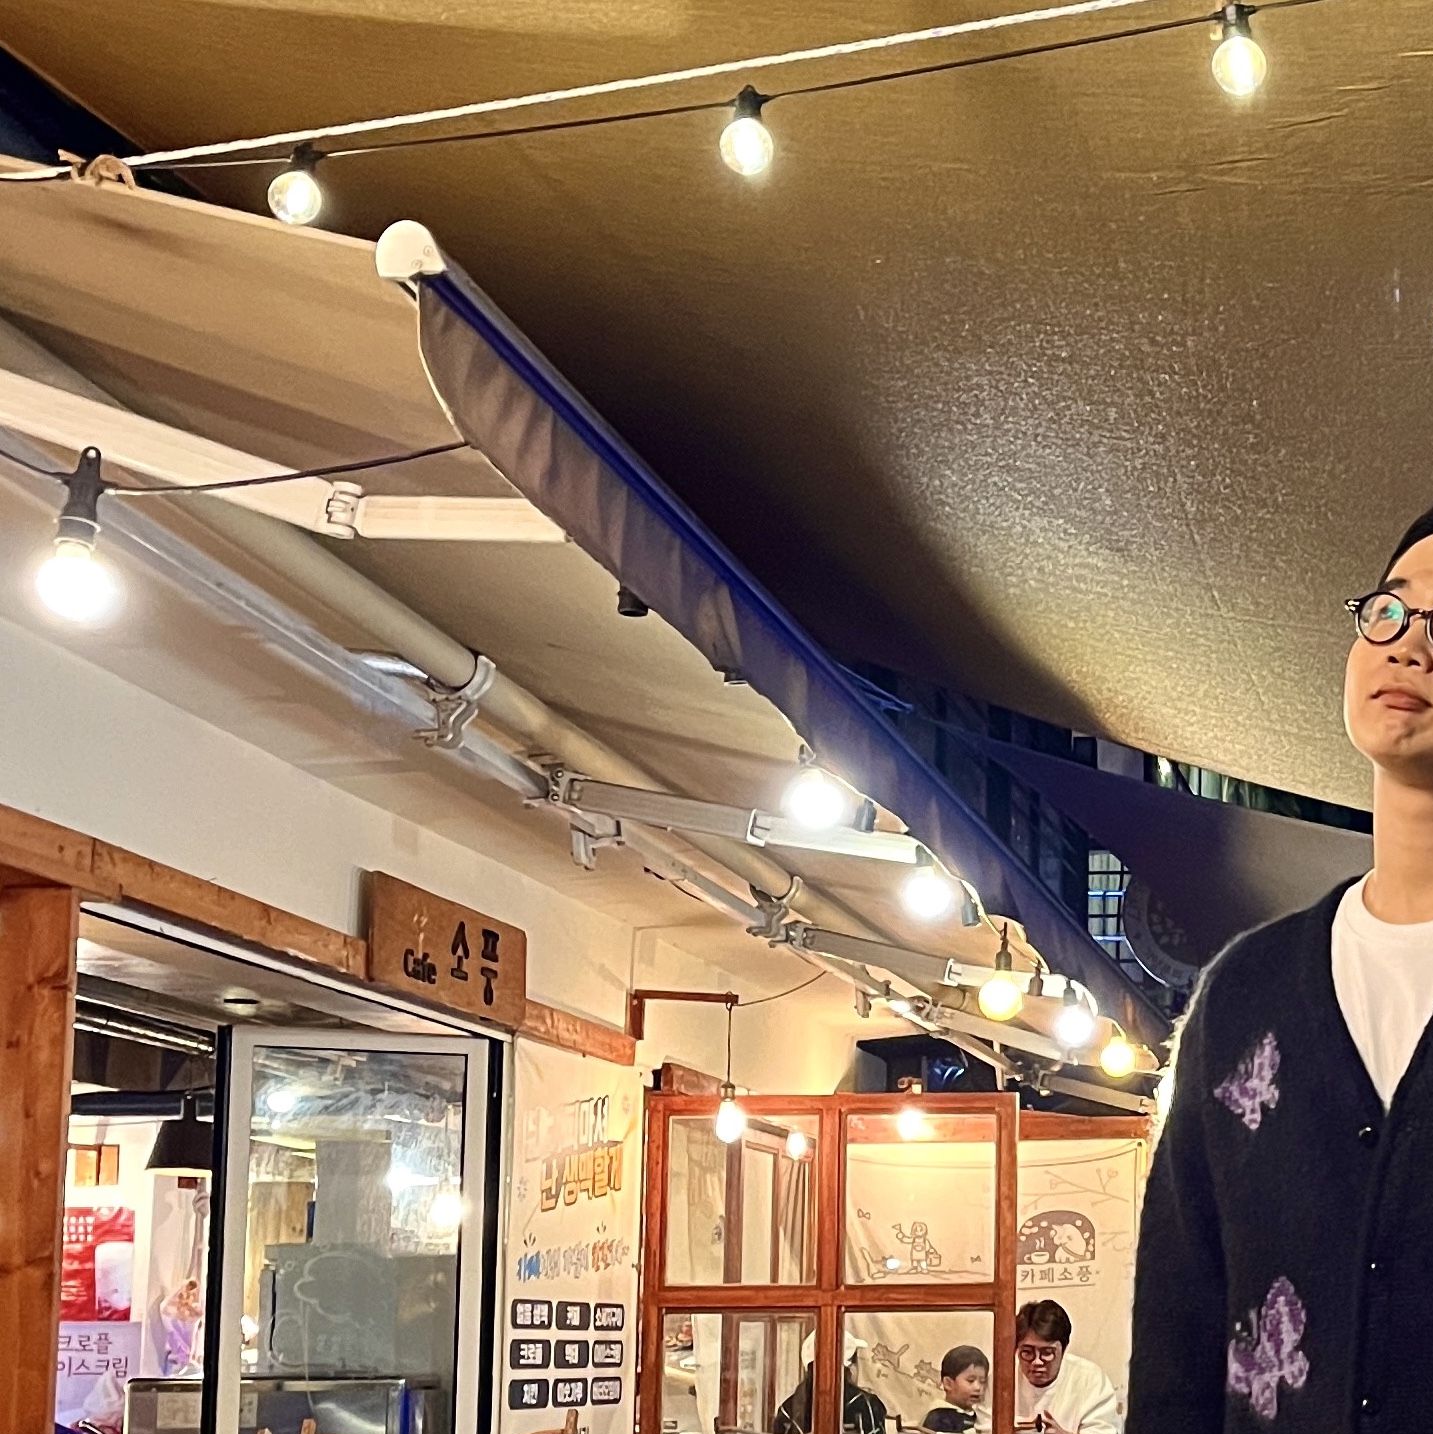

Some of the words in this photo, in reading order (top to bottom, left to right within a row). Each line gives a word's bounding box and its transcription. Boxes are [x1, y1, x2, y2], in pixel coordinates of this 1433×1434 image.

[403, 948, 437, 985] Cafe
[540, 1157, 559, 1212] 난
[1018, 1265, 1093, 1284] 카페소풍
[57, 1332, 113, 1354] 크로플
